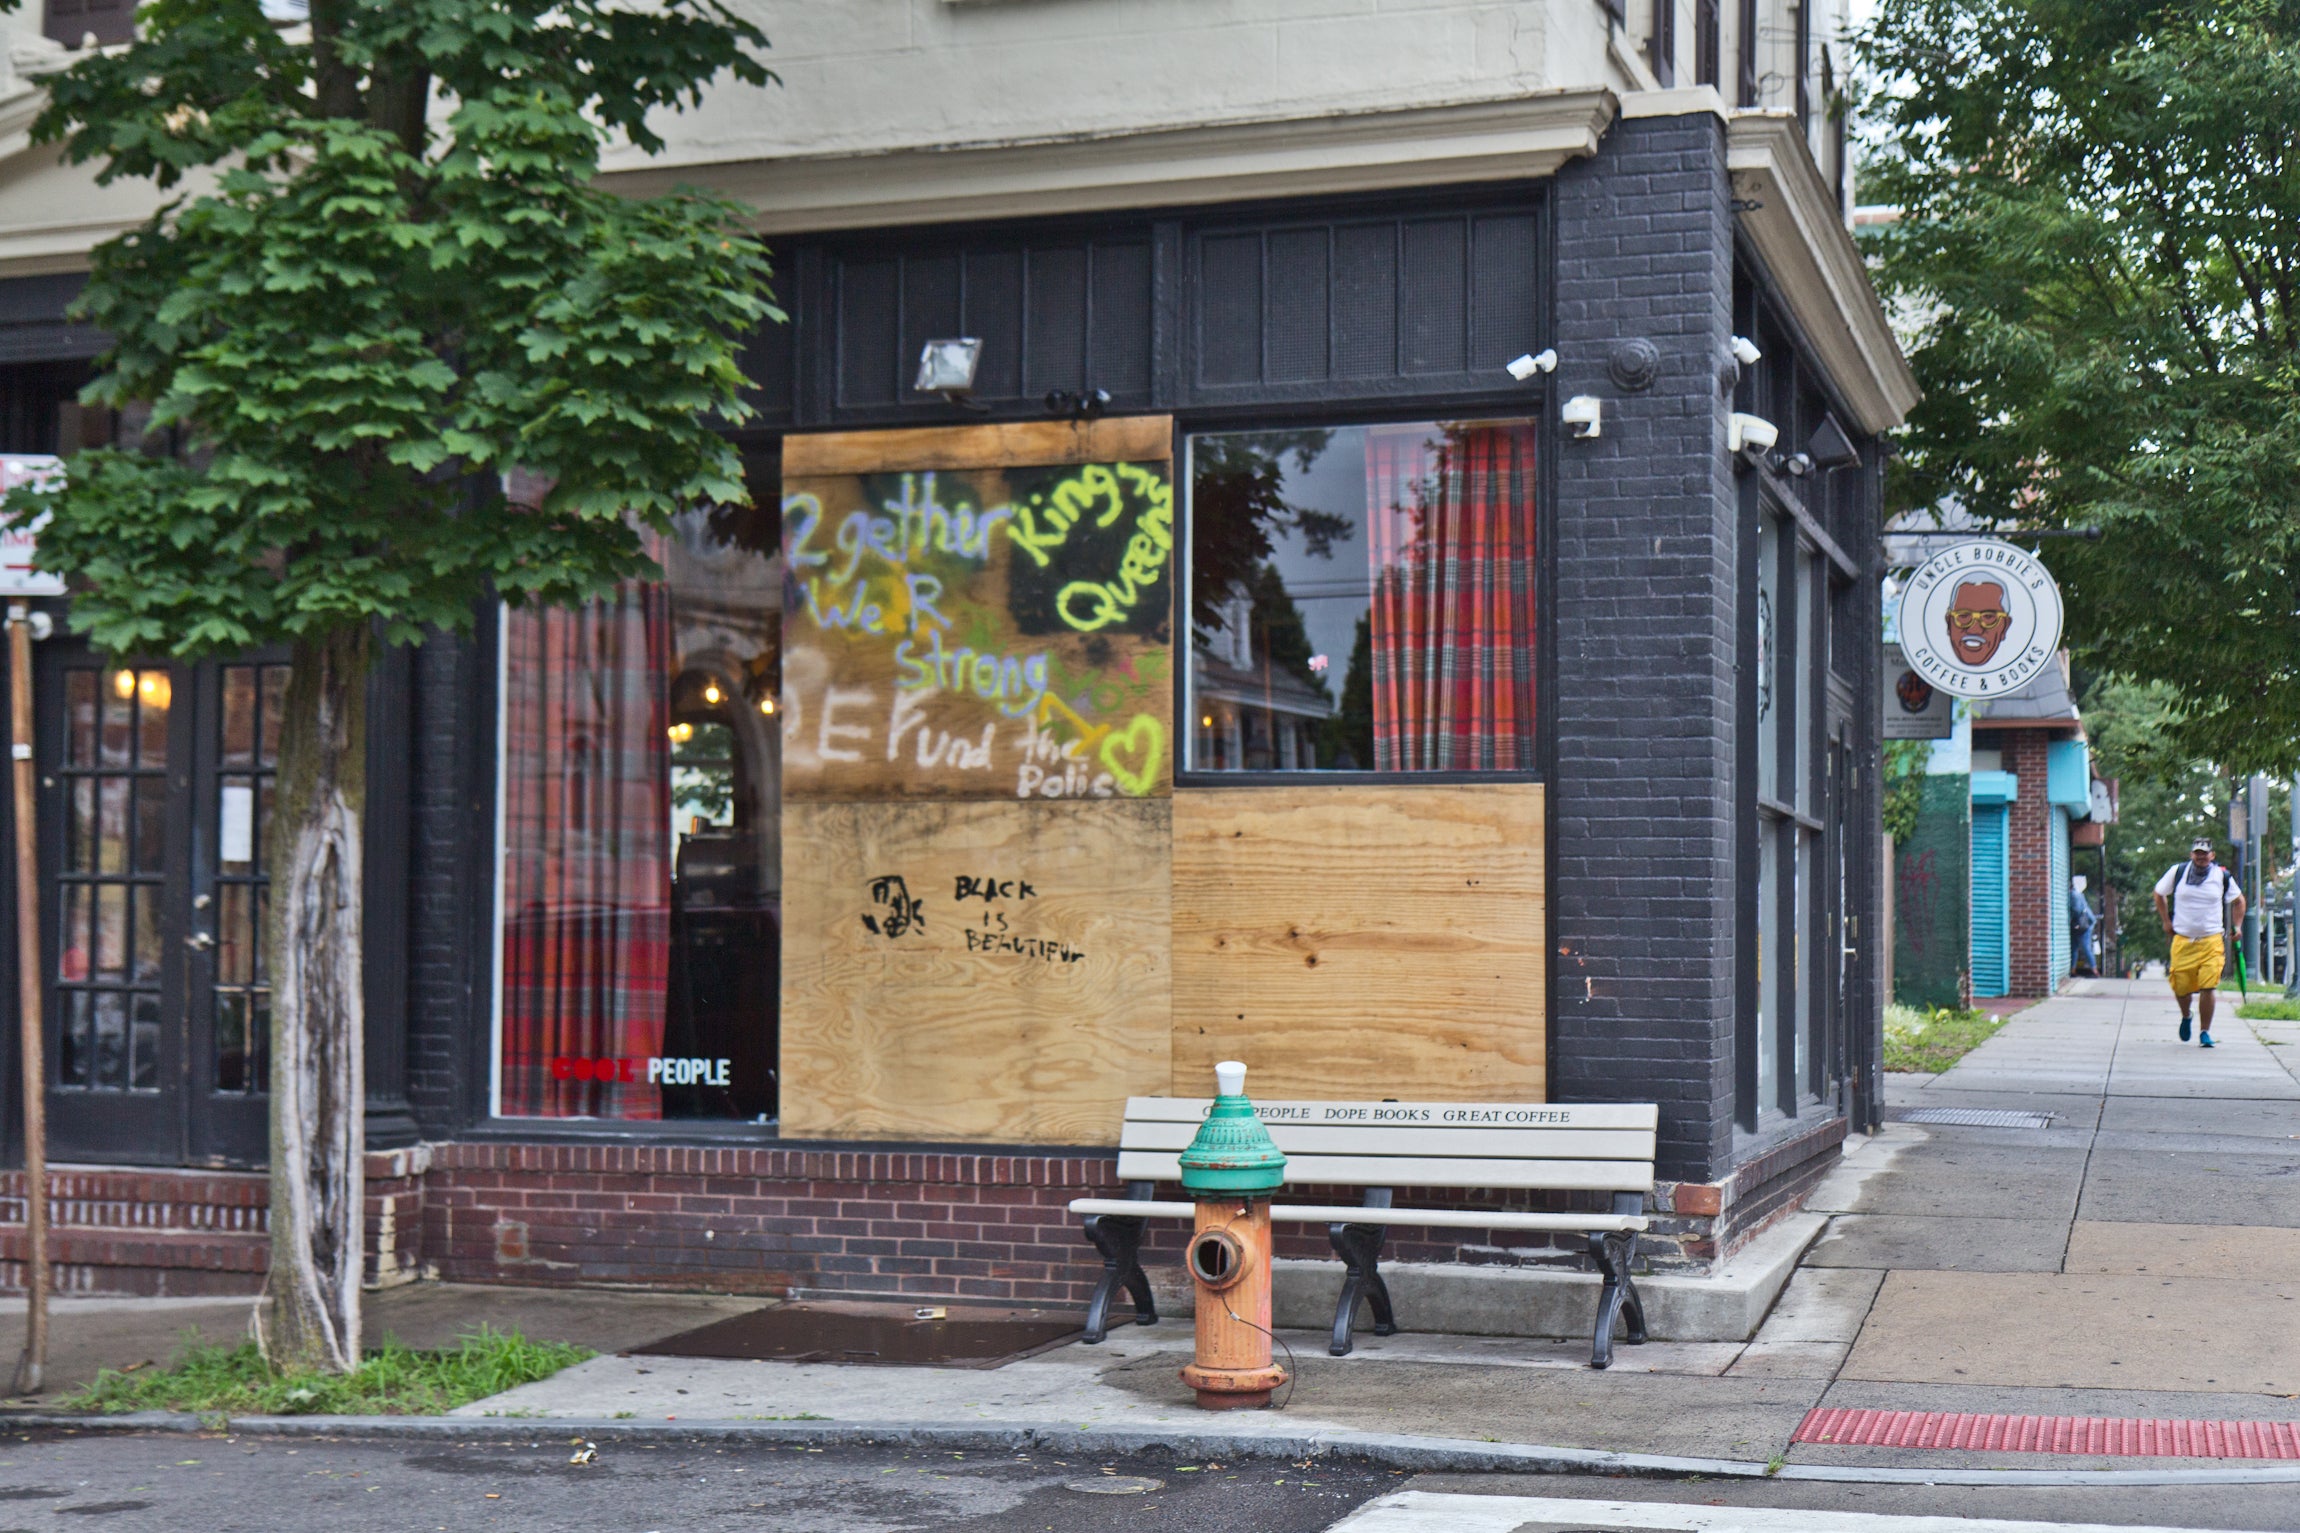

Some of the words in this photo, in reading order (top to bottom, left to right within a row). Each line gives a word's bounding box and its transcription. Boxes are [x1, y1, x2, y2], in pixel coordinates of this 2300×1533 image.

[1916, 551, 1961, 590] UNCLE
[1974, 547, 2045, 589] BOBBIE'S
[801, 576, 884, 636] We
[905, 572, 952, 632] R
[893, 629, 1048, 719] Strong
[1915, 648, 1968, 689] COFFEE
[1979, 678, 1989, 691] &
[1999, 646, 2044, 687] BOOKS
[954, 875, 1038, 903] BLACK
[983, 911, 1009, 932] IS
[552, 1056, 634, 1082] COOL
[647, 1057, 731, 1086] PEOPLE
[1254, 1106, 1311, 1119] PEOPLE
[1324, 1108, 1368, 1120] DOPE
[1373, 1108, 1430, 1121] BOOKS
[1443, 1109, 1502, 1122] GREAT
[1505, 1110, 1571, 1123] COFFEE
